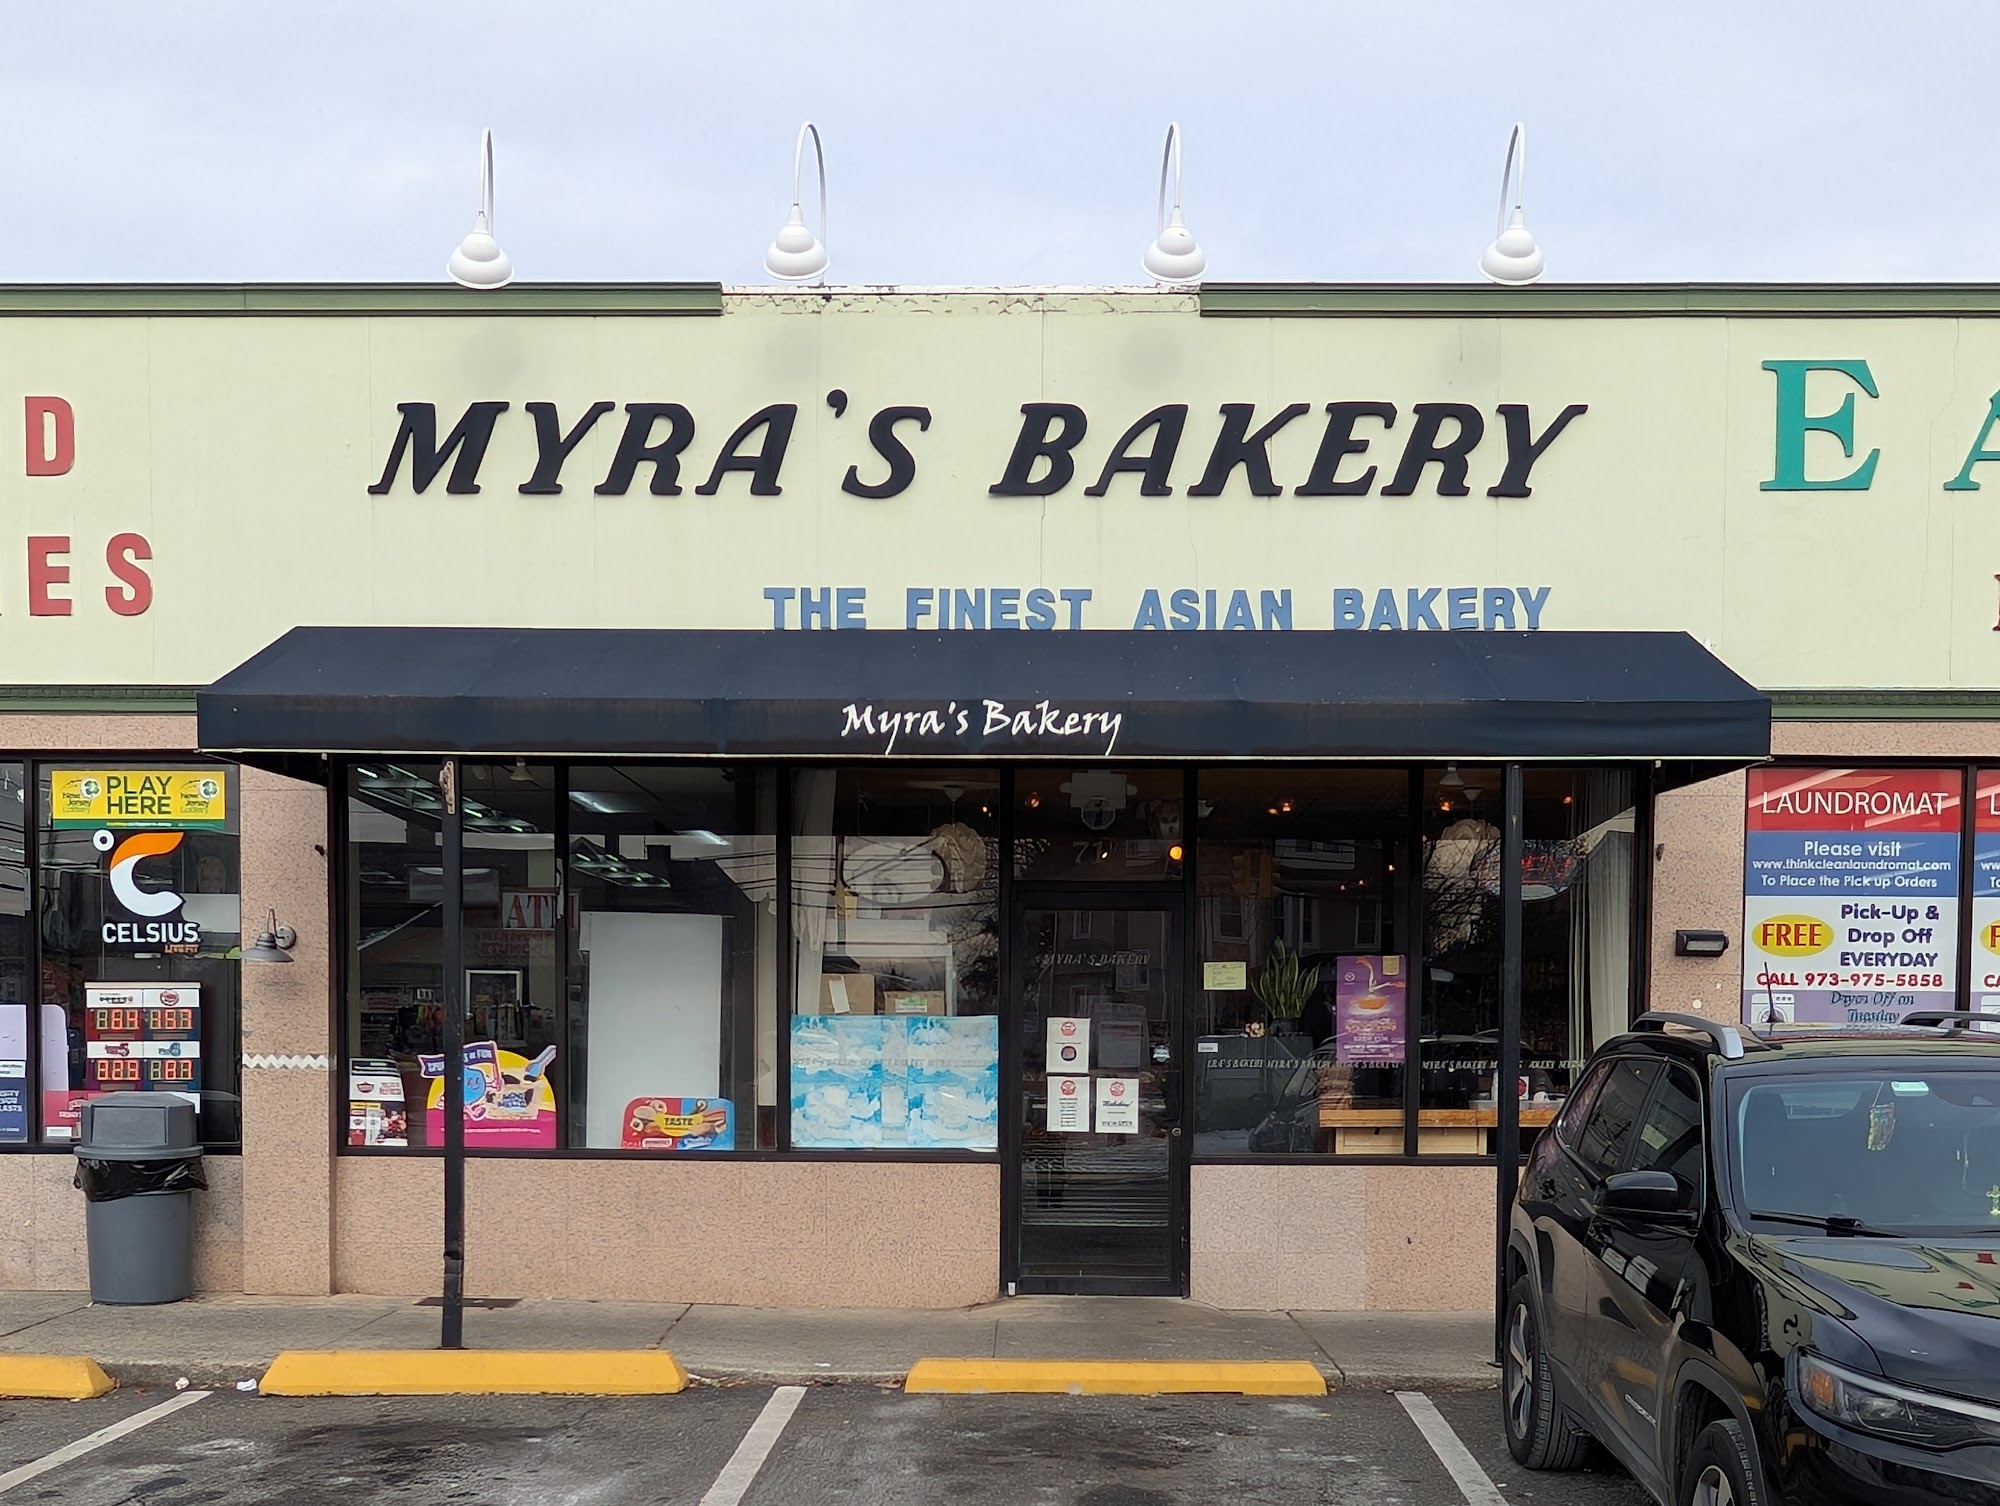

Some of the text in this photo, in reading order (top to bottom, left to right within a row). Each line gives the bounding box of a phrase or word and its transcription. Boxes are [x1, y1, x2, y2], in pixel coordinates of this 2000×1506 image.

[367, 389, 1589, 498] MYRA'S BAKERY
[0, 533, 152, 616] ES
[763, 586, 1552, 631] THE FINEST ASIAN BAKERY
[841, 699, 1123, 756] Myra's Bakery
[106, 775, 173, 795] PLAY
[106, 796, 172, 815] HERE
[1761, 791, 1949, 815] LAUNDROMAT
[1803, 840, 1902, 857] Please visit
[1752, 858, 1951, 871] www.thinkcleanlaundromat.com
[1761, 875, 1776, 886] To
[1779, 875, 1816, 887] Place
[1819, 876, 1840, 887] the
[1894, 875, 1938, 888] Orders
[1840, 903, 1940, 924] Pick-Up &
[101, 922, 199, 943] CELSIUS
[1761, 923, 1822, 947] FREE
[1847, 927, 1933, 948] Drop Off
[1840, 951, 1939, 967] EVERYDAY
[1756, 972, 1944, 988] CALL 973-975-5858
